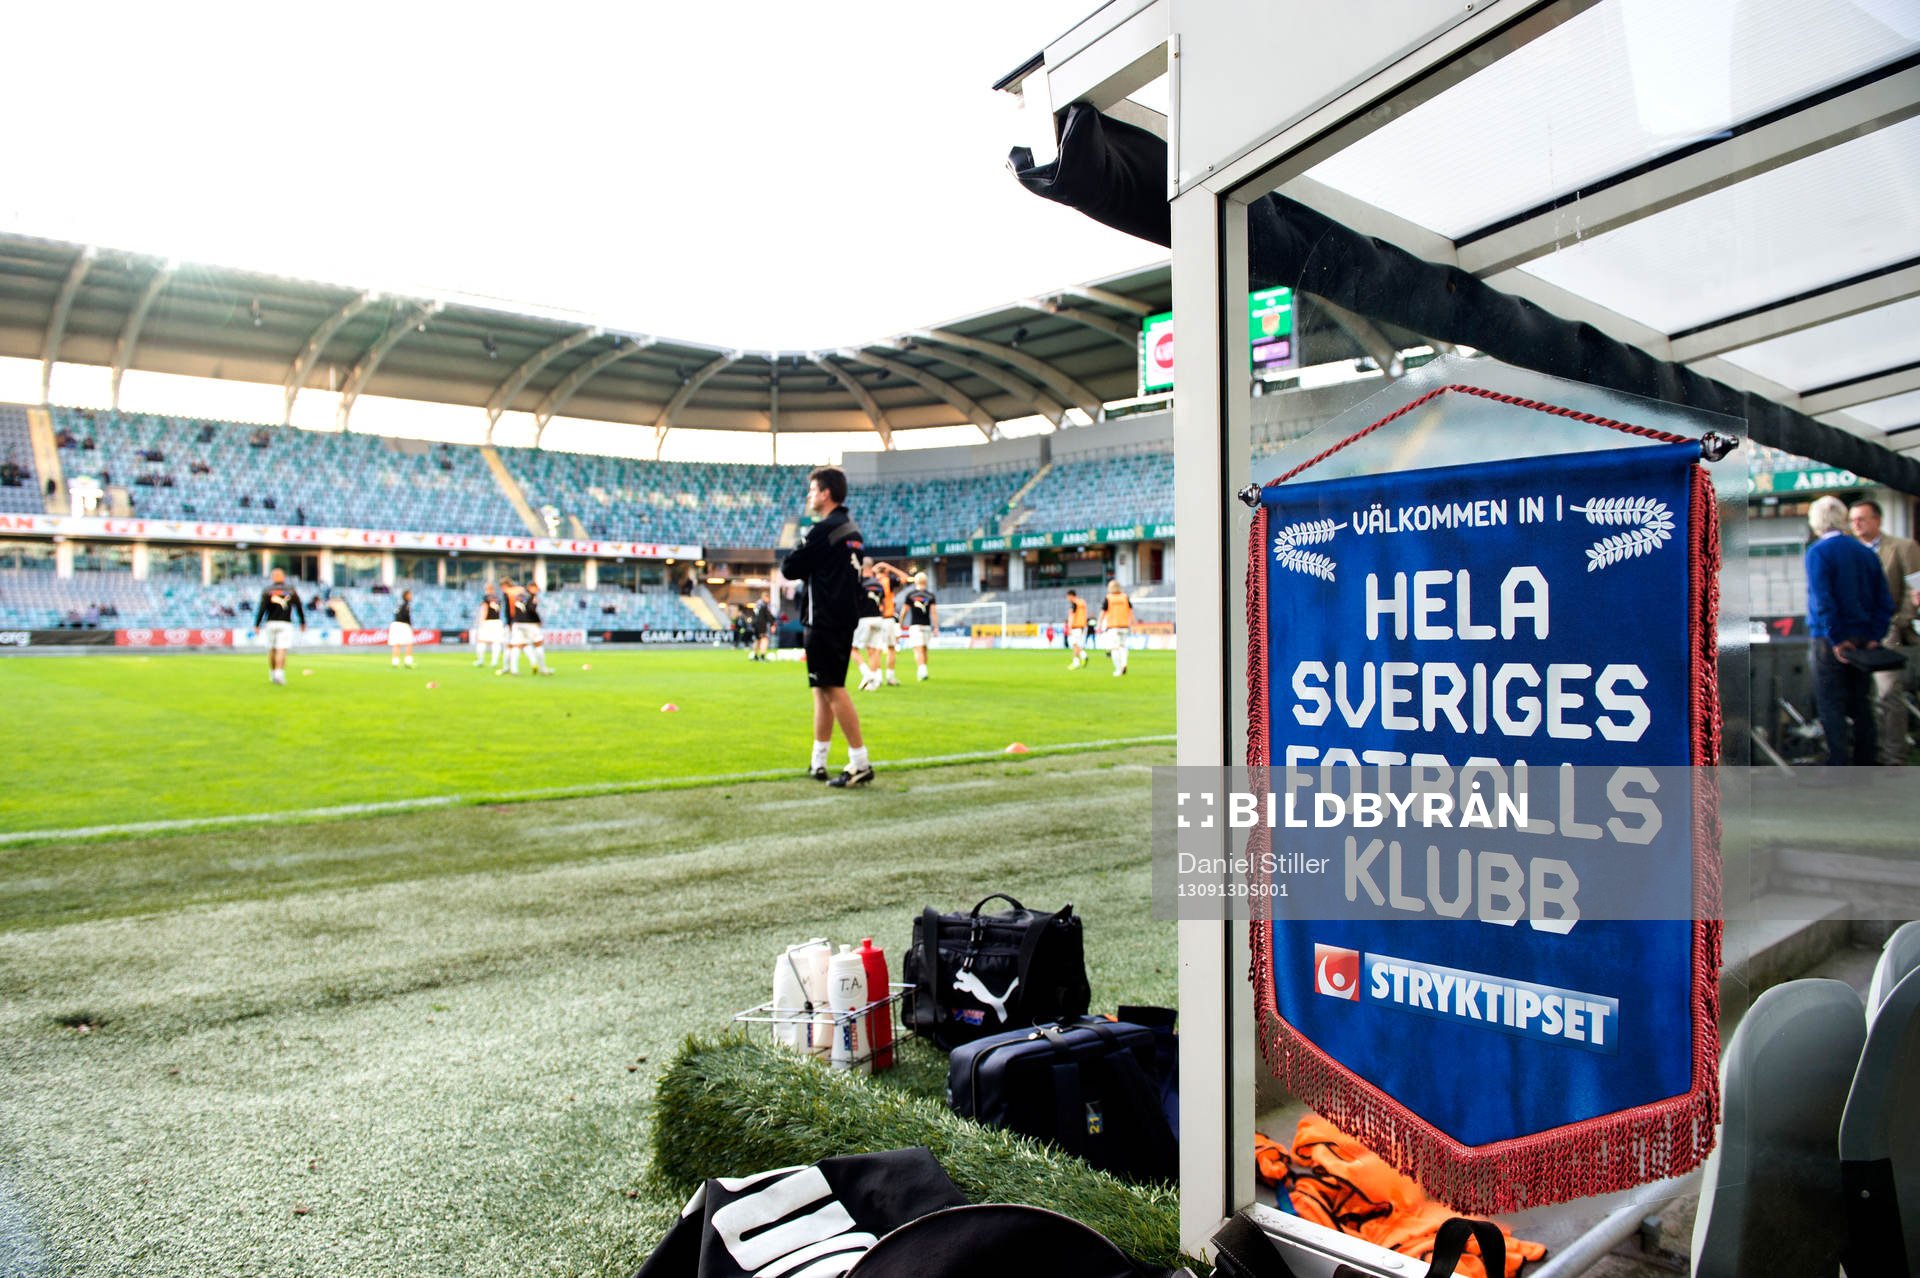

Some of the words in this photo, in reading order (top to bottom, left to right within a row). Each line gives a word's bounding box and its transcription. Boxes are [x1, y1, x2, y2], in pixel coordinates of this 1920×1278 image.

[1352, 498, 1508, 536] VÄLKOMMEN
[1518, 495, 1544, 525] IN
[1555, 494, 1564, 522] I
[1365, 566, 1550, 641] HELA
[1291, 660, 1652, 743] SVERIGES
[1285, 744, 1663, 846] FOTBOLLS
[1344, 835, 1581, 935] KLUBB
[1370, 962, 1611, 1046] STRYKTIPSET
